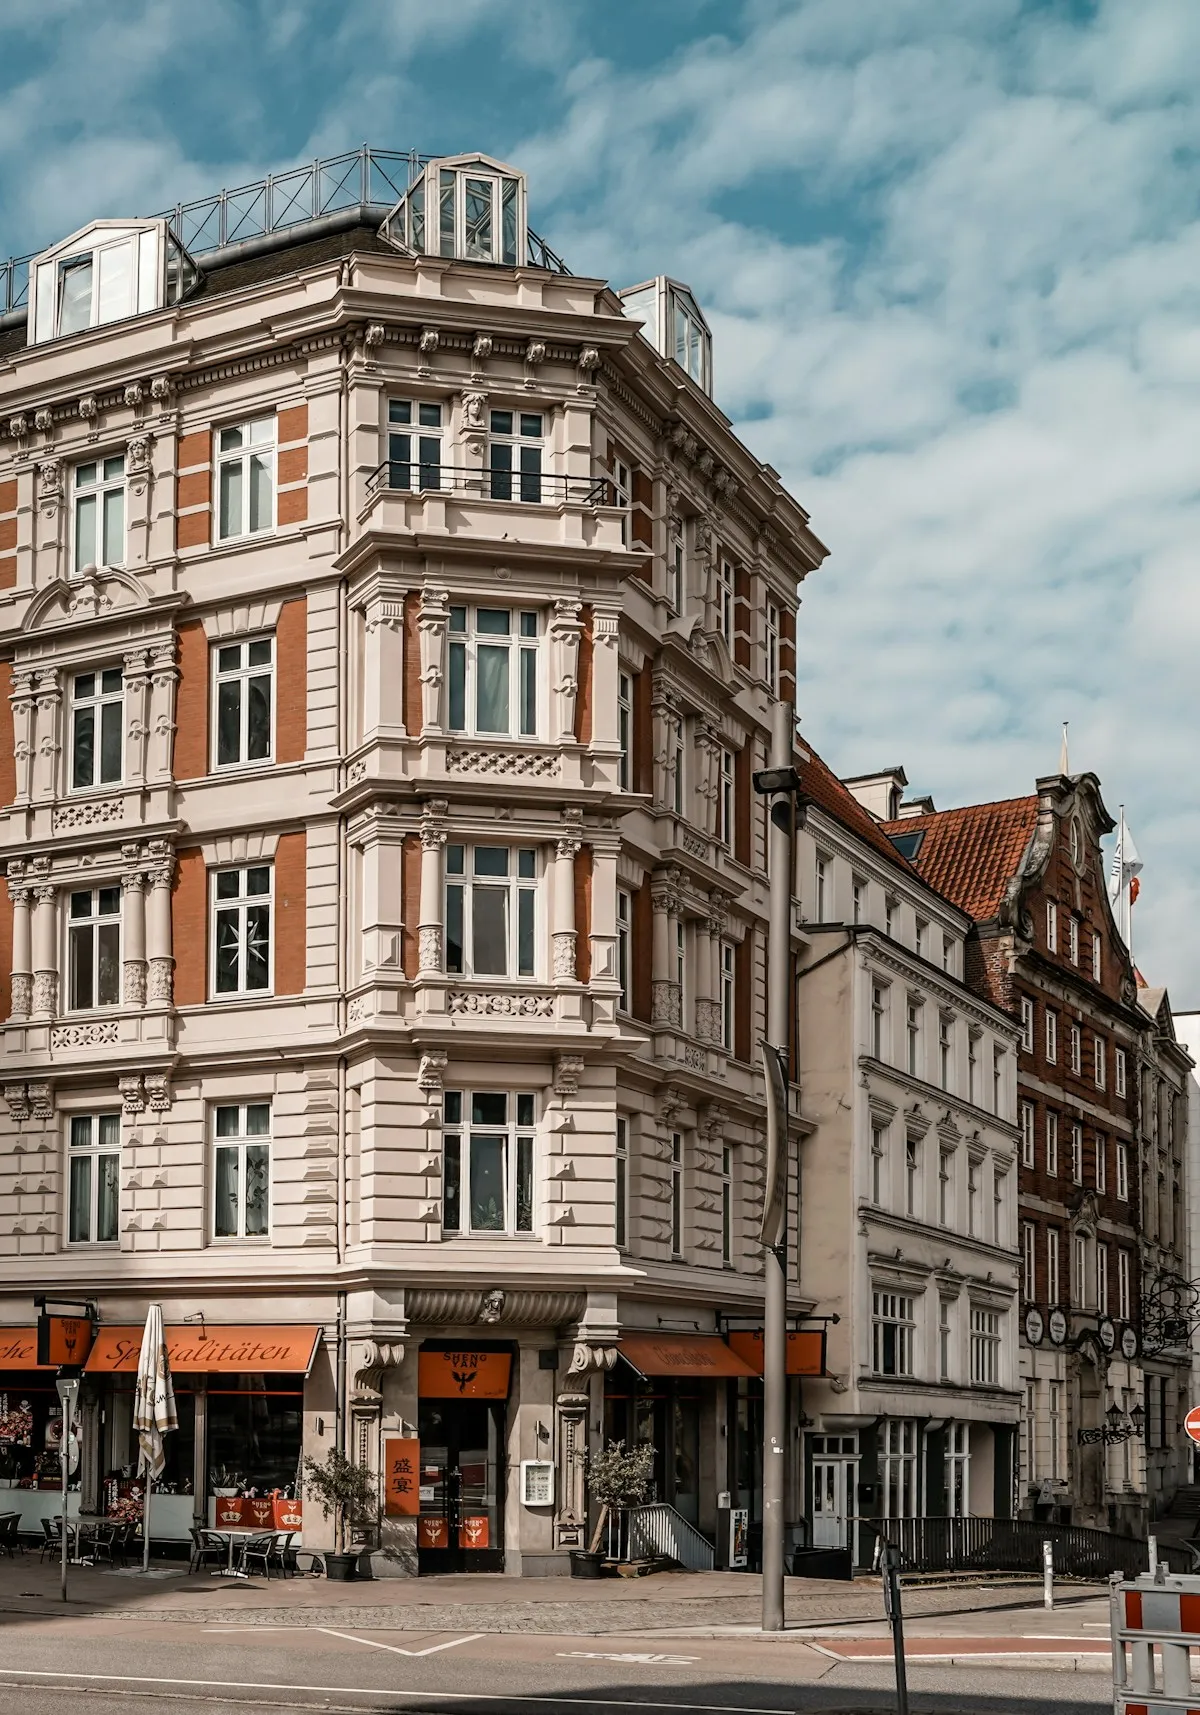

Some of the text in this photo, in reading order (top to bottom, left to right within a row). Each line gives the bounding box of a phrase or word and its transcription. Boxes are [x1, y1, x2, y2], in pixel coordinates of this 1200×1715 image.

[106, 1339, 292, 1368] Spialitäten
[443, 1352, 487, 1362] SHENG
[771, 1436, 777, 1444] 6
[392, 1458, 414, 1493] 盛宴
